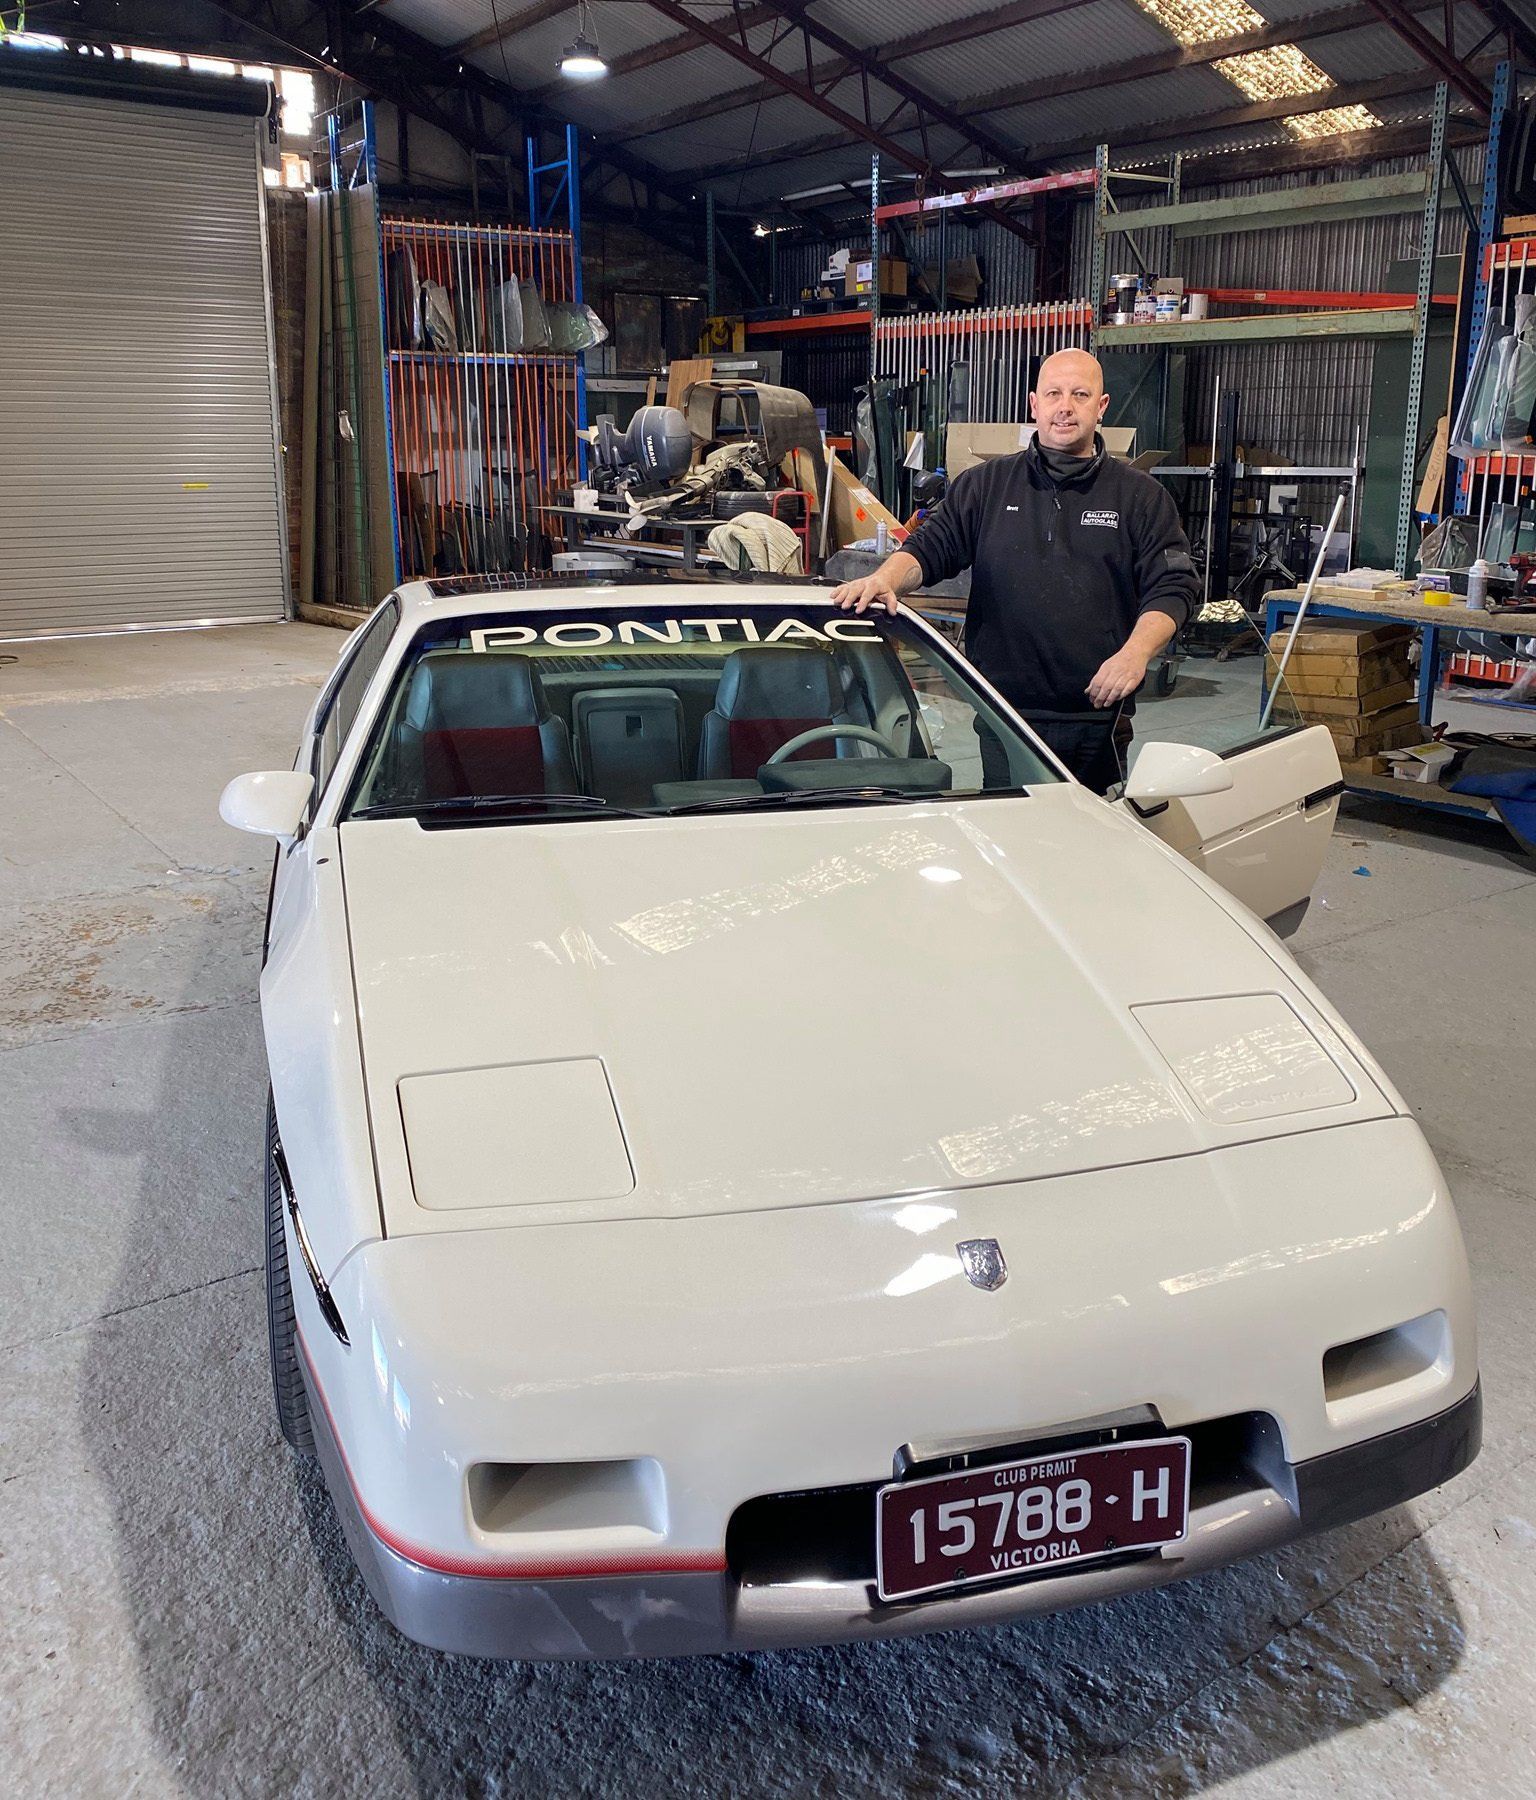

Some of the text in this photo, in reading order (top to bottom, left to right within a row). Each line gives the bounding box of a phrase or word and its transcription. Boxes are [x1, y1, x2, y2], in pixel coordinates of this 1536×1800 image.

[646, 435, 658, 467] YAMAHA
[470, 619, 884, 653] PONTIAC
[993, 1458, 1078, 1487] CLUB PERMIT
[909, 1466, 1170, 1564] 15788 H
[990, 1538, 1081, 1570] VICTORIA
